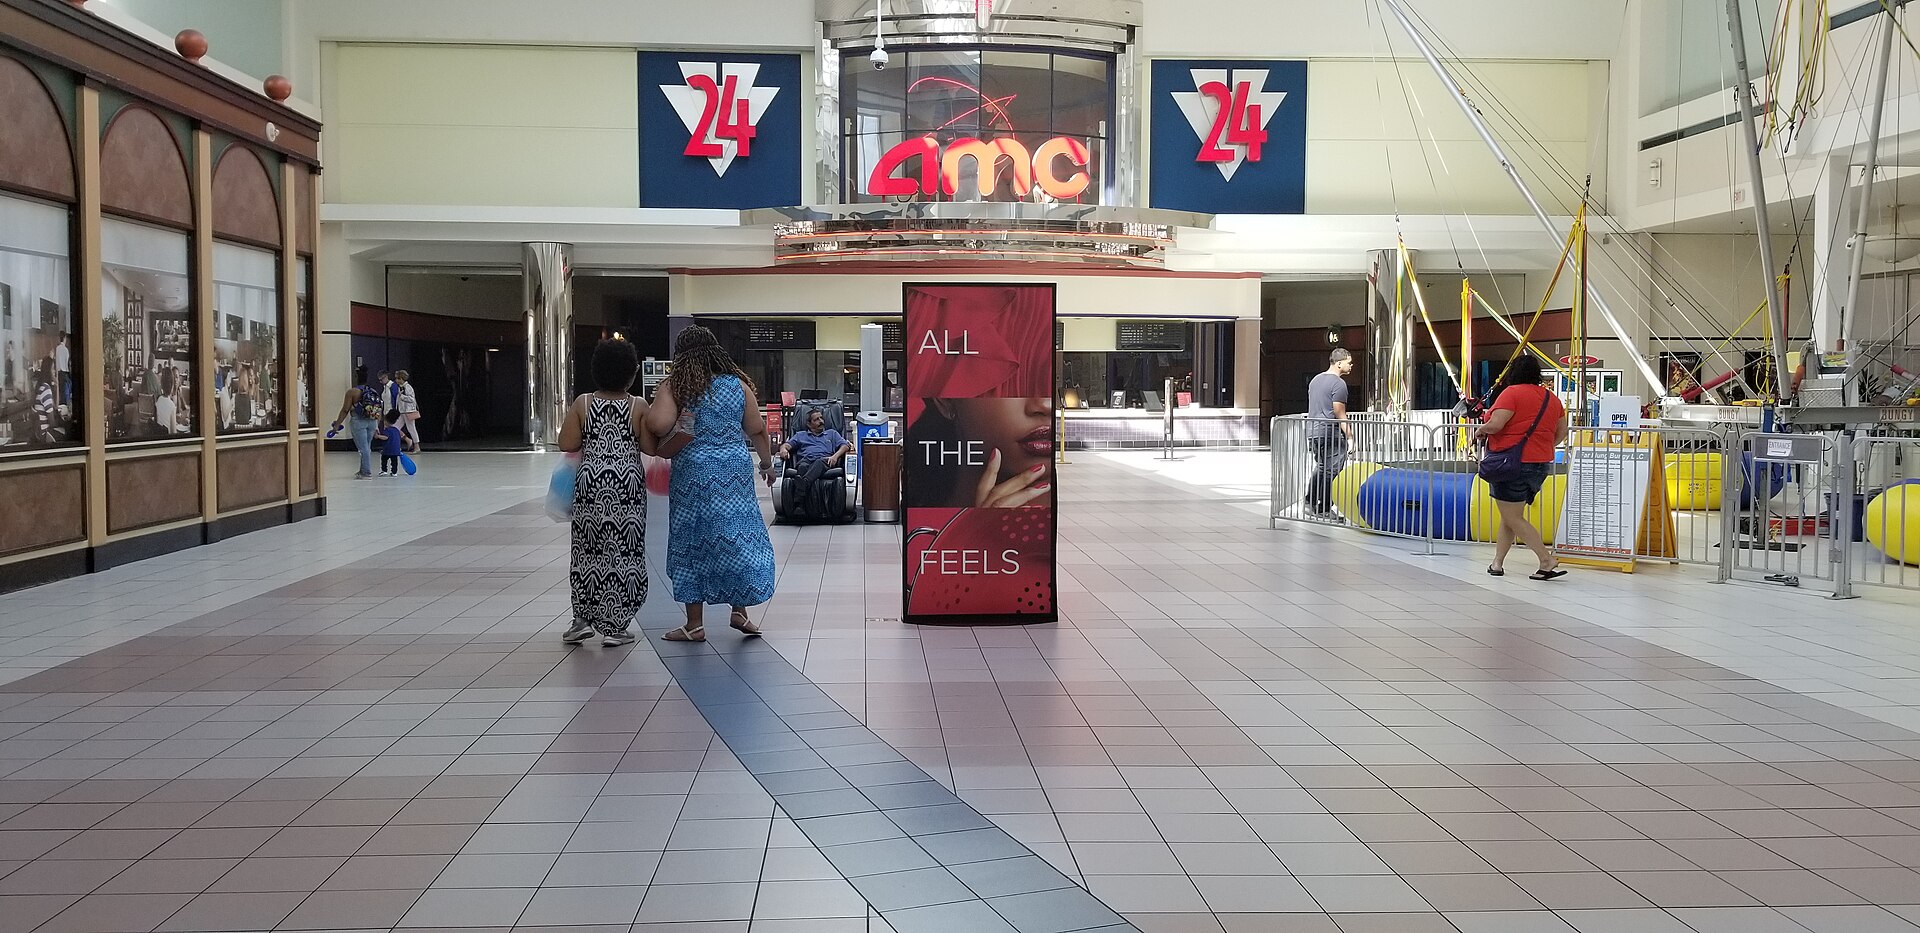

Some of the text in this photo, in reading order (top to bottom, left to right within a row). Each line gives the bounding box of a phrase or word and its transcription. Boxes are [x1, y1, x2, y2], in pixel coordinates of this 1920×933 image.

[683, 74, 757, 158] 24
[1196, 81, 1267, 162] 24
[867, 137, 1090, 199] amc
[918, 329, 979, 355] ALL
[1611, 413, 1628, 421] OPEN
[1718, 408, 1740, 420] BUNGY
[1881, 409, 1914, 420] BUNGY
[918, 440, 984, 466] THE
[1768, 441, 1791, 450] ENTRANCE
[919, 549, 1021, 575] FEELS
